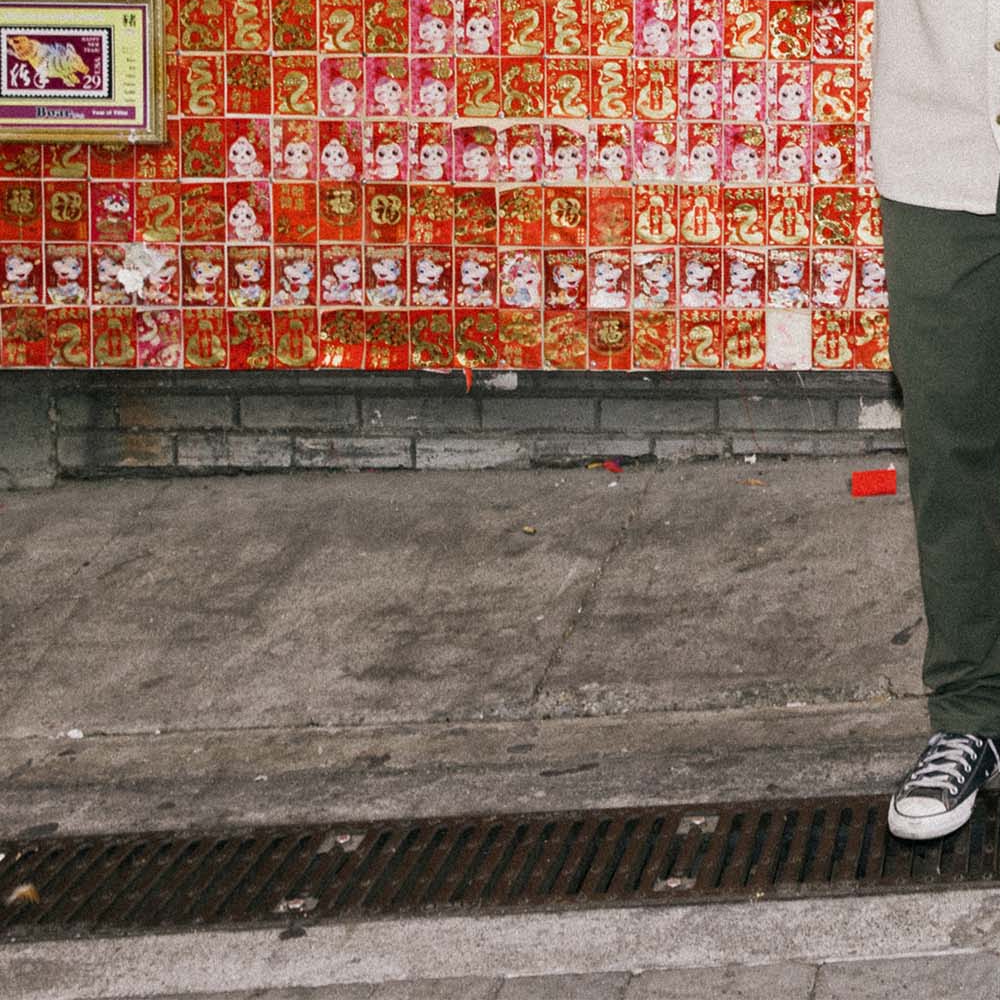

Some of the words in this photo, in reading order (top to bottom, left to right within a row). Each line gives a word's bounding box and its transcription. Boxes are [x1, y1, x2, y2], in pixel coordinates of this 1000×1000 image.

[82, 75, 101, 89] 29
[36, 106, 72, 118] Boar
[51, 191, 80, 222] 福
[371, 195, 401, 225] 福
